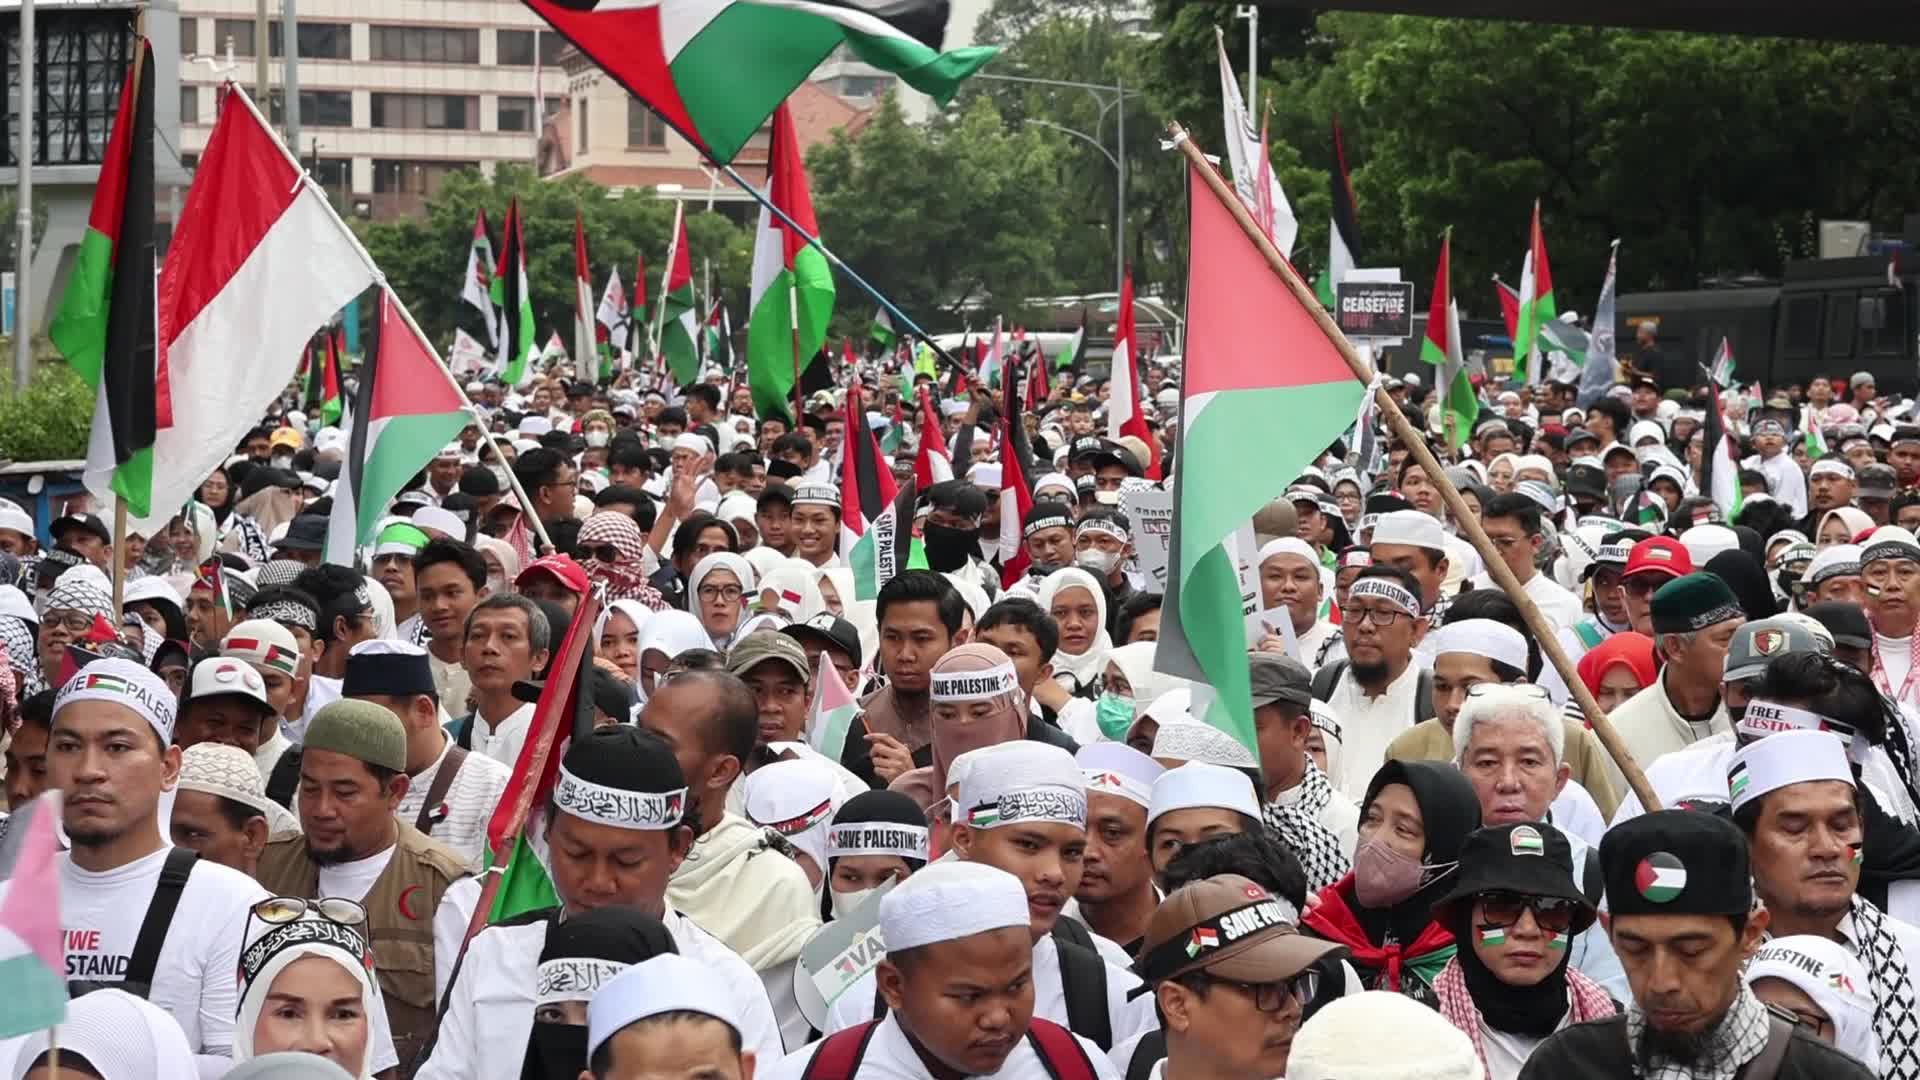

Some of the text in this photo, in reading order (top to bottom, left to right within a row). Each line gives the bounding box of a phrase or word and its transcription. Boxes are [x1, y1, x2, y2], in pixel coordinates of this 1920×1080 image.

[1371, 581, 1411, 607] PALESTINE
[951, 676, 1001, 695] PALESTINE
[1751, 706, 1785, 721] FREE
[837, 829, 918, 850] SAVE PALESTINE
[1219, 906, 1265, 941] SAVE
[69, 930, 101, 951] WE
[65, 954, 128, 976] STAND
